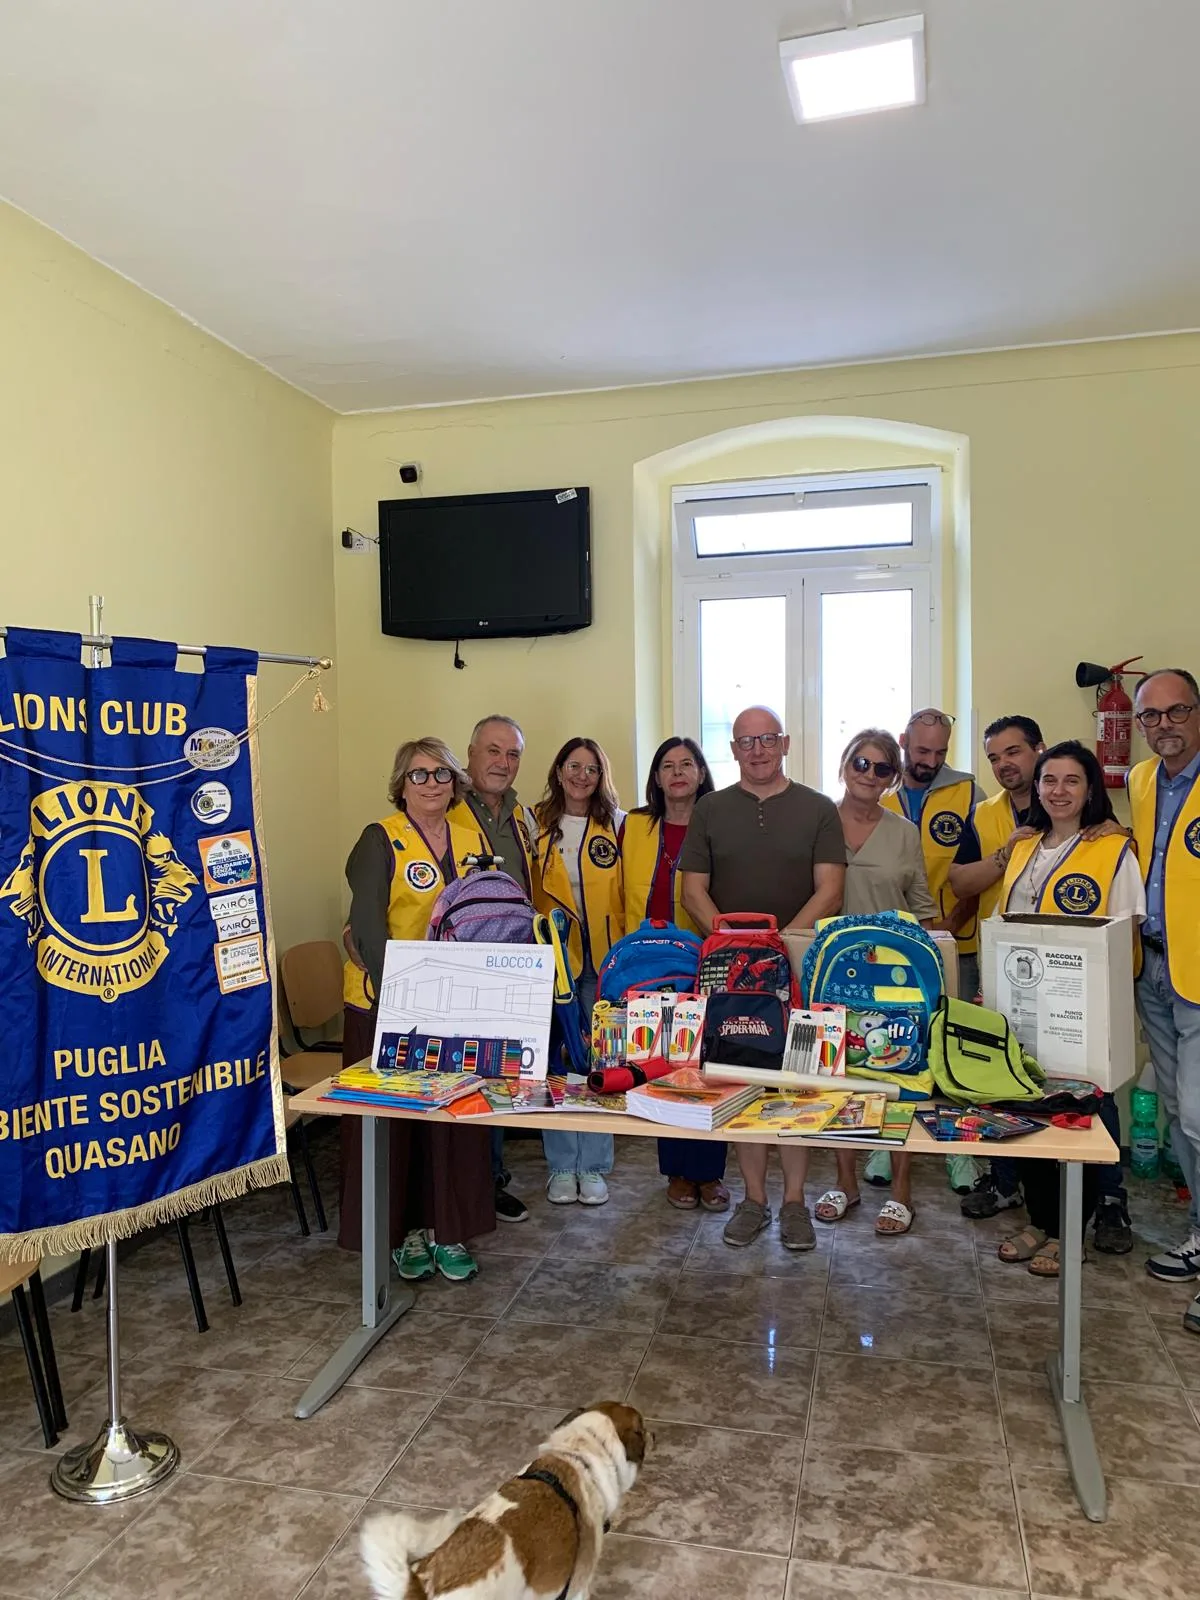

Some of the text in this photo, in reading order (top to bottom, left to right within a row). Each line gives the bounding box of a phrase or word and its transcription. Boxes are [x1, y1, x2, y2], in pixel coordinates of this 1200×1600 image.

[101, 701, 188, 736] CLUB
[32, 785, 147, 833] LIONS
[943, 822, 952, 834] L
[599, 845, 608, 856] L
[79, 849, 139, 923] L
[1068, 878, 1092, 888] LIONS
[1072, 887, 1083, 900] L
[41, 941, 160, 986] INTERNATIONAL
[486, 956, 543, 969] BLOCCO 4
[1045, 953, 1083, 961] RACCOLTA
[1048, 959, 1083, 967] SOLIDALE
[720, 1024, 770, 1036] SPIDER-MAN
[54, 1039, 166, 1080] PUGLIA
[99, 1051, 266, 1123] SOSTENIBILE
[45, 1122, 181, 1179] QUASANO
